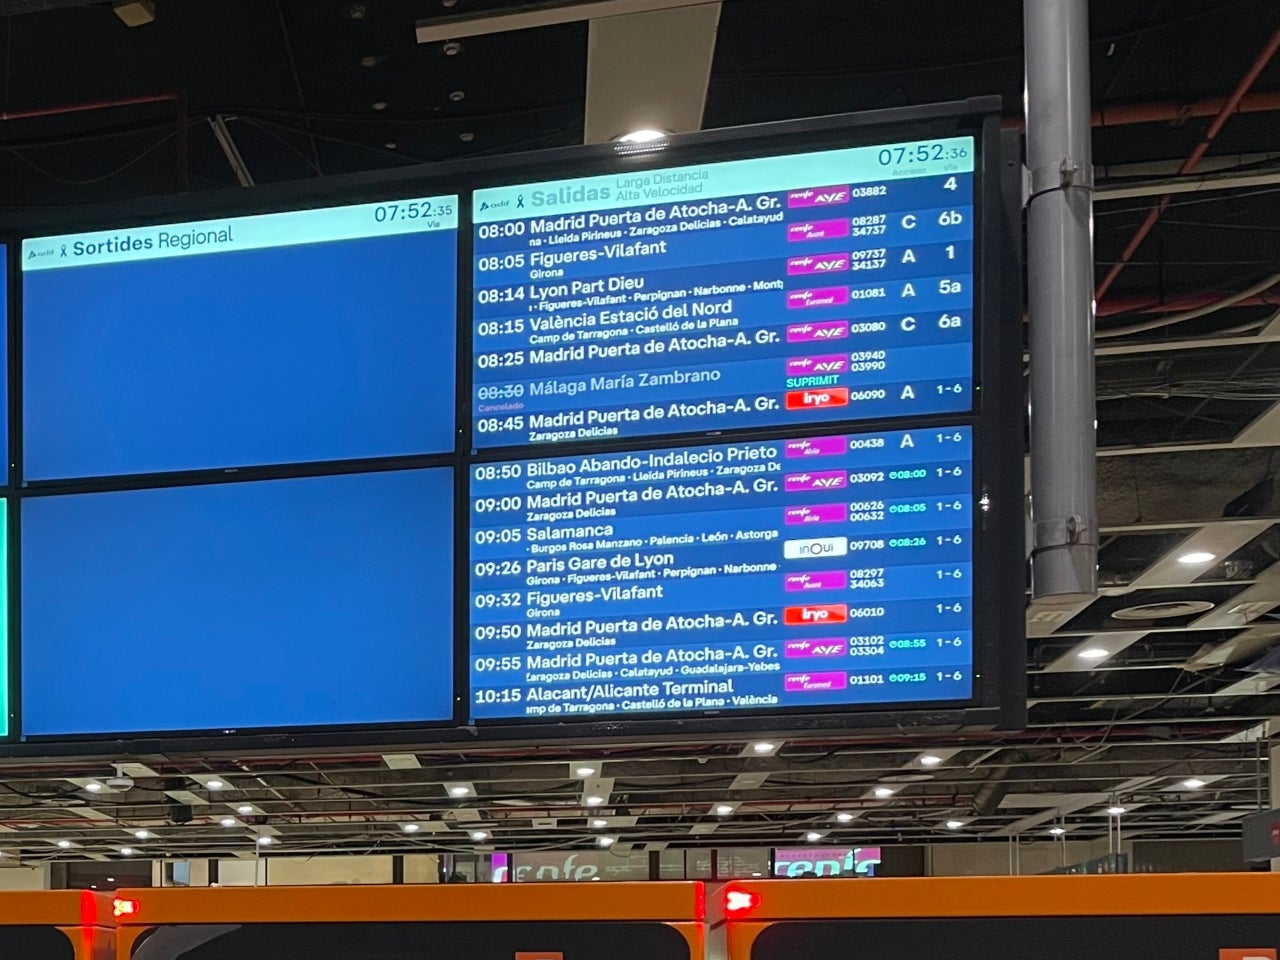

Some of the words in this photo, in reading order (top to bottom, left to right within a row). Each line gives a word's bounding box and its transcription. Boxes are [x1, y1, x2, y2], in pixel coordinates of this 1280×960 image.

[878, 144, 967, 166] 07:52:36
[616, 172, 651, 190] Larga
[653, 169, 709, 186] Distancia
[943, 177, 958, 191] 4
[531, 185, 610, 207] Salidas
[616, 189, 641, 203] Alta
[642, 182, 703, 200] Velocidad
[852, 186, 887, 198] 03882
[374, 202, 453, 223] 07:52:35
[478, 222, 525, 239] 08:00
[530, 214, 586, 234] Madrid
[589, 208, 642, 228] Puerta
[645, 207, 666, 221] de
[669, 198, 752, 220] Atocha-A.
[756, 195, 782, 210] Gr.
[852, 214, 886, 226] 08287
[938, 210, 962, 226] 6b
[581, 228, 622, 242] Pirineus
[629, 223, 678, 238] Zaragoza
[680, 219, 721, 232] Delicias
[729, 212, 783, 228] Calatayud
[852, 225, 886, 236] 34737
[901, 215, 916, 229] C
[73, 236, 153, 256] Sortides
[158, 226, 234, 250] Regional
[478, 255, 524, 272] 08:05
[530, 240, 667, 266] Figueres-Vilafant
[530, 268, 564, 280] Girona
[478, 287, 524, 304] 08:14
[530, 283, 568, 301] Lyon
[572, 279, 605, 296] Part
[608, 276, 645, 291] Dieu
[939, 280, 961, 294] 5a
[478, 319, 524, 336] 08:15
[530, 311, 596, 331] València
[600, 305, 659, 325] Estació
[662, 303, 688, 318] del
[692, 299, 733, 316] Nord
[635, 321, 679, 335] Castelló
[681, 319, 694, 330] de
[697, 318, 707, 329] la
[708, 316, 738, 328] Plana
[851, 321, 886, 333] 03080
[529, 333, 559, 345] Camp
[562, 332, 575, 342] de
[577, 327, 628, 340] Tarragona
[478, 351, 524, 368] 08:25
[530, 345, 585, 364] Madrid
[588, 338, 640, 358] Puerta
[644, 336, 665, 352] de
[668, 329, 751, 352] Atocha-A.
[755, 328, 780, 344] Gr.
[851, 351, 885, 362] 03940
[851, 361, 885, 373] 03990
[530, 378, 586, 397] Málaga
[590, 373, 634, 391] María
[638, 367, 721, 387] Zambrano
[786, 374, 839, 389] SUPRIMIT
[803, 392, 830, 406] iryo
[851, 389, 885, 401] 06090
[900, 385, 915, 399] A
[477, 416, 524, 433] 08:45
[529, 410, 584, 429] Madrid
[587, 404, 640, 424] Puerta
[643, 402, 664, 418] de
[667, 395, 751, 418] Atocha-A.
[755, 395, 780, 411] Gr.
[850, 438, 885, 450] 00438
[475, 465, 521, 481] 08:50
[527, 460, 576, 477] Bilbao
[580, 450, 723, 473] Abando-Indalecio
[727, 445, 777, 461] Prieto
[475, 497, 521, 512] 09:00
[526, 510, 574, 523] Zaragoza
[576, 506, 616, 519] Delicias
[475, 529, 521, 544] 09:05
[527, 523, 614, 541] Salamanca
[850, 539, 884, 551] 09708
[475, 561, 521, 577] 09:26
[527, 556, 565, 574] Paris
[568, 554, 607, 570] Gare
[610, 552, 631, 568] de
[634, 551, 674, 568] Lyon
[475, 593, 521, 608] 09:32
[527, 584, 663, 606] Figueres-Vilafant
[850, 606, 885, 618] 06010
[475, 625, 521, 640] 09:50
[850, 635, 884, 647] 03102
[475, 657, 521, 672] 09:55
[527, 652, 581, 669] Madrid
[585, 649, 638, 666] Puerta
[642, 647, 663, 663] de
[666, 643, 750, 662] Atocha-A.
[753, 643, 778, 658] Gr.
[850, 674, 884, 685] 01101
[475, 689, 521, 703] 10:15
[527, 683, 659, 701] Alacant/Alicante
[662, 679, 734, 696] Terminal
